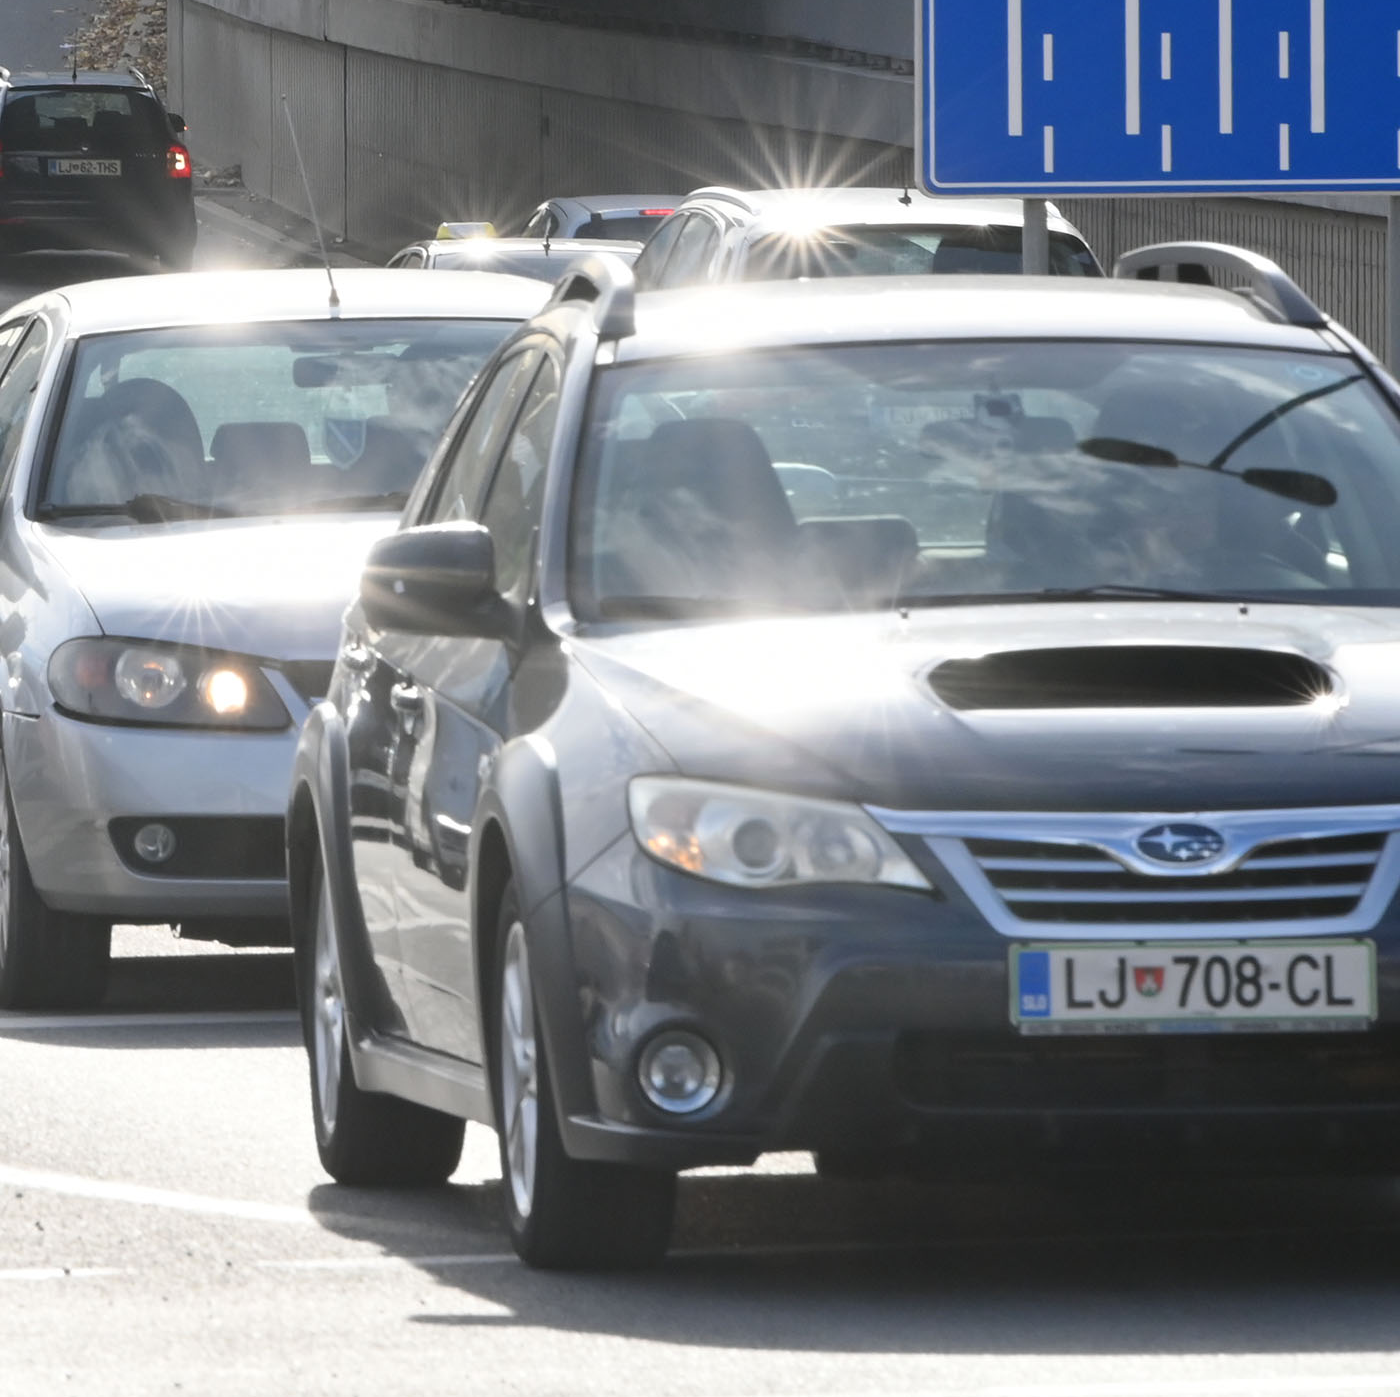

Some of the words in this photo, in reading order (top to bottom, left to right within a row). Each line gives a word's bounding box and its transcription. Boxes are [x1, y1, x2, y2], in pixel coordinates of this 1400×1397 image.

[58, 162, 72, 173] LJ
[80, 162, 118, 173] 62-THS
[1021, 994, 1048, 1011] SLO
[1065, 957, 1127, 1010] LJ
[1172, 954, 1354, 1010] 708-CL
